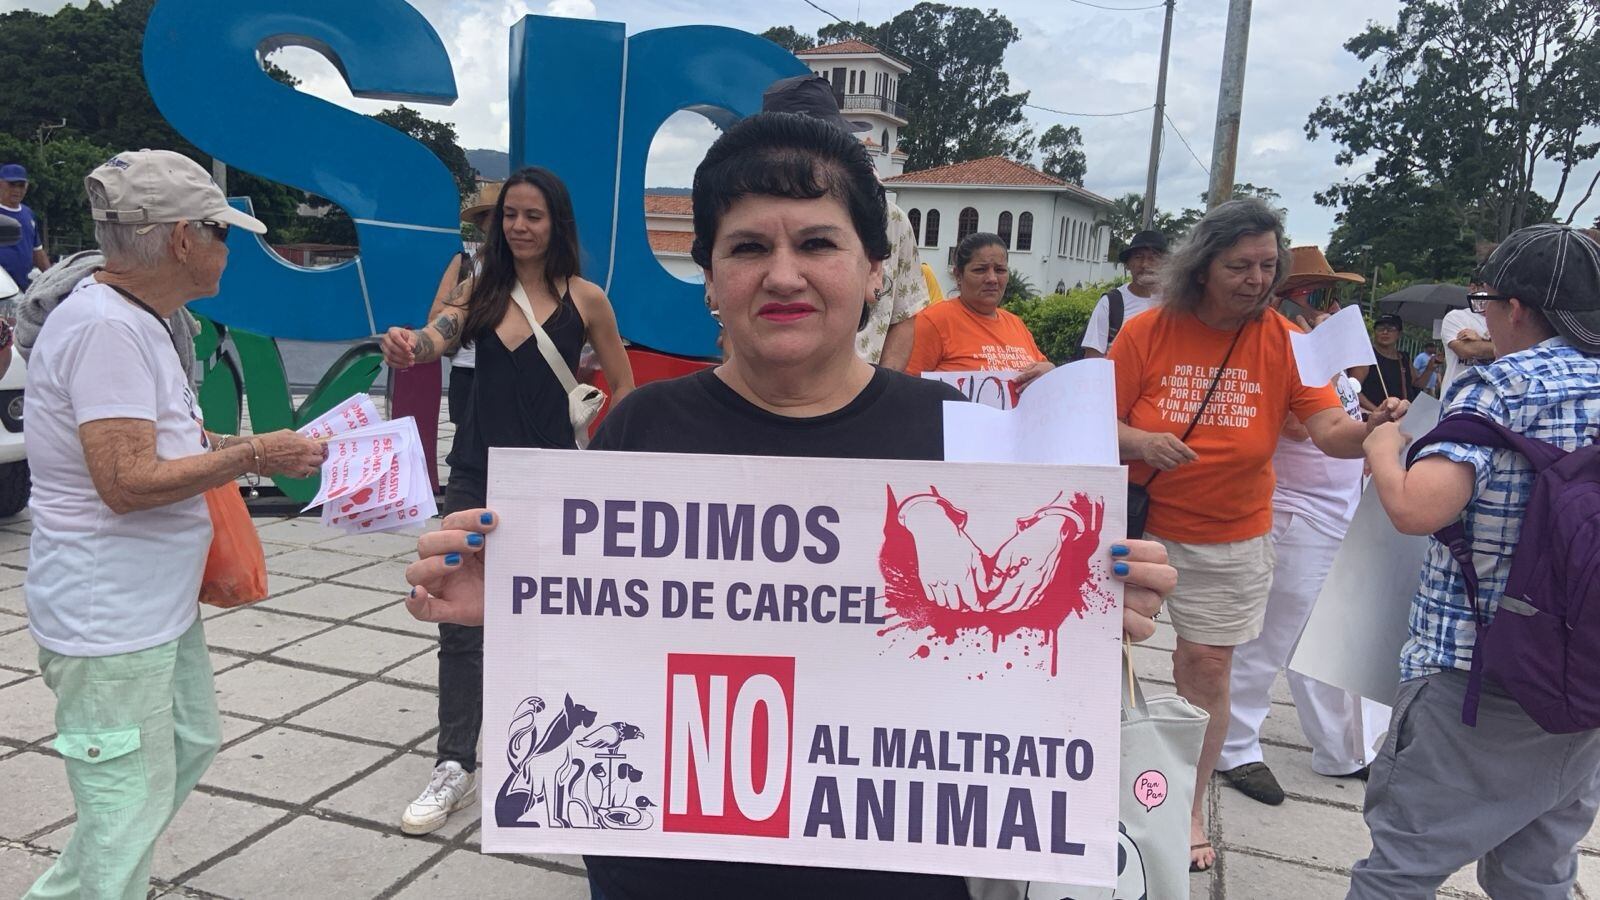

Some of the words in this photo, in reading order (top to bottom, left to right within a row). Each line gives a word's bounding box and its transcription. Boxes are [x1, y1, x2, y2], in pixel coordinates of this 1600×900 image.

[1175, 365, 1192, 376] POR
[1195, 366, 1206, 377] EL
[1161, 376, 1167, 387] A
[1224, 380, 1237, 392] DE
[1240, 381, 1264, 396] VIDA,
[1170, 388, 1189, 399] POR
[1191, 389, 1202, 401] EL
[1204, 390, 1246, 405] ERECHO
[1157, 398, 1164, 408] A
[1166, 399, 1180, 410] UN
[1230, 405, 1257, 418] SANO
[1161, 410, 1168, 420] Y
[1170, 411, 1190, 424] UNA
[1217, 415, 1249, 428] SALUD
[563, 499, 839, 564] PEDIMOS
[513, 576, 648, 617] PENAS
[663, 581, 713, 619] DE
[727, 582, 886, 624] CARCEL
[669, 674, 789, 821] NO
[808, 725, 860, 766] AL
[873, 727, 1094, 781] MALTRATO
[1141, 778, 1159, 790] Pan
[1146, 789, 1163, 800] Pan
[803, 776, 1085, 856] ANIMAL
